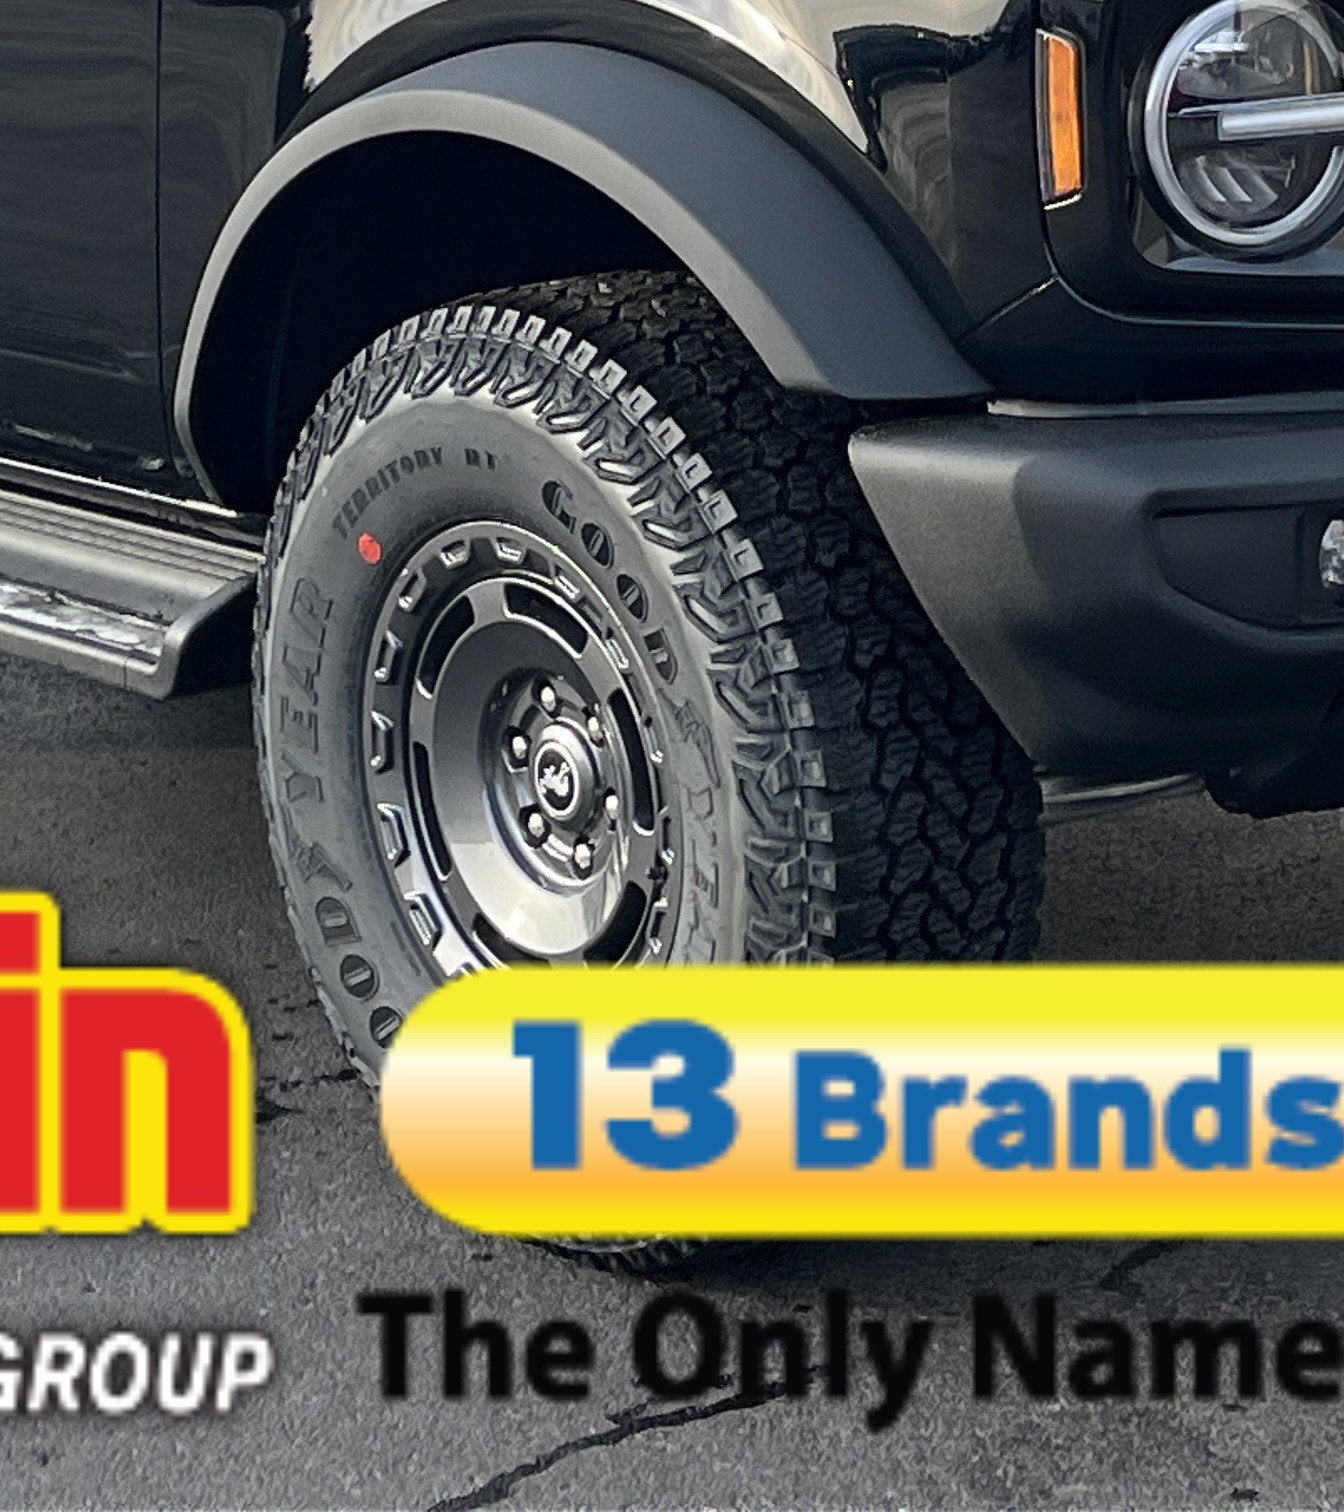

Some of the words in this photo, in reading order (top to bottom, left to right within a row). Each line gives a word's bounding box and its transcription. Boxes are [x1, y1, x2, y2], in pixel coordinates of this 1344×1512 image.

[332, 446, 442, 539] TERRITORY
[464, 447, 498, 471] RT
[280, 578, 404, 1048] OODYEAR
